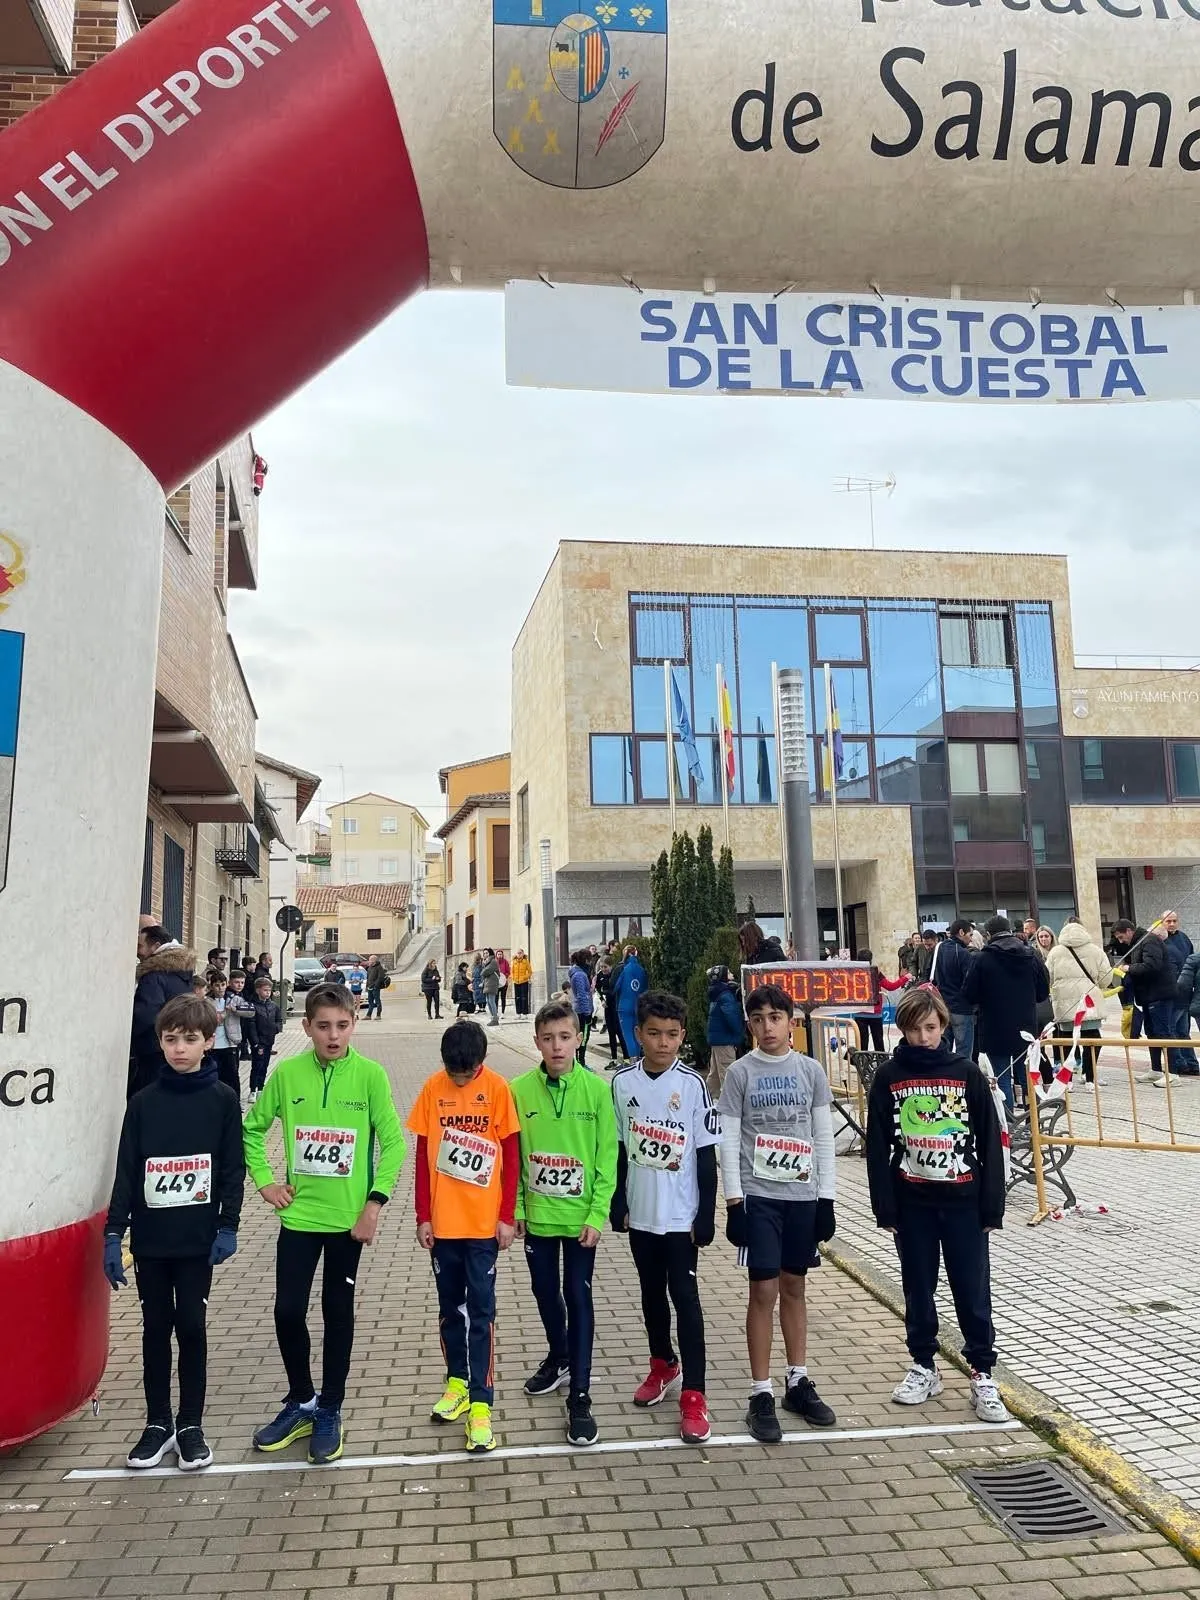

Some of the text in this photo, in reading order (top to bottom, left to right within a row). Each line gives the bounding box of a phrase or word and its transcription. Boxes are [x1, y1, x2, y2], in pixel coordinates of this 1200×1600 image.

[731, 61, 822, 153] de
[0, 0, 329, 266] N EL DEPORTE
[640, 300, 1168, 355] SAN CRISTOBAL
[669, 347, 1147, 398] DE LA CUESTA
[1098, 688, 1199, 704] AYUNTAMIENTO
[757, 1076, 798, 1090] ADIDAS
[750, 1092, 807, 1108] ORIGINALS
[440, 1115, 489, 1127] CAMPUS
[443, 1130, 496, 1157] bedunia
[639, 1138, 671, 1160] 439
[757, 1136, 811, 1154] bedunia
[907, 1136, 952, 1149] bedunia
[303, 1144, 340, 1163] 448
[448, 1148, 483, 1171] 430
[766, 1152, 802, 1171] 444
[916, 1151, 948, 1168] 442
[147, 1158, 209, 1173] bedunia
[155, 1173, 196, 1194] 449
[538, 1167, 571, 1185] 432
